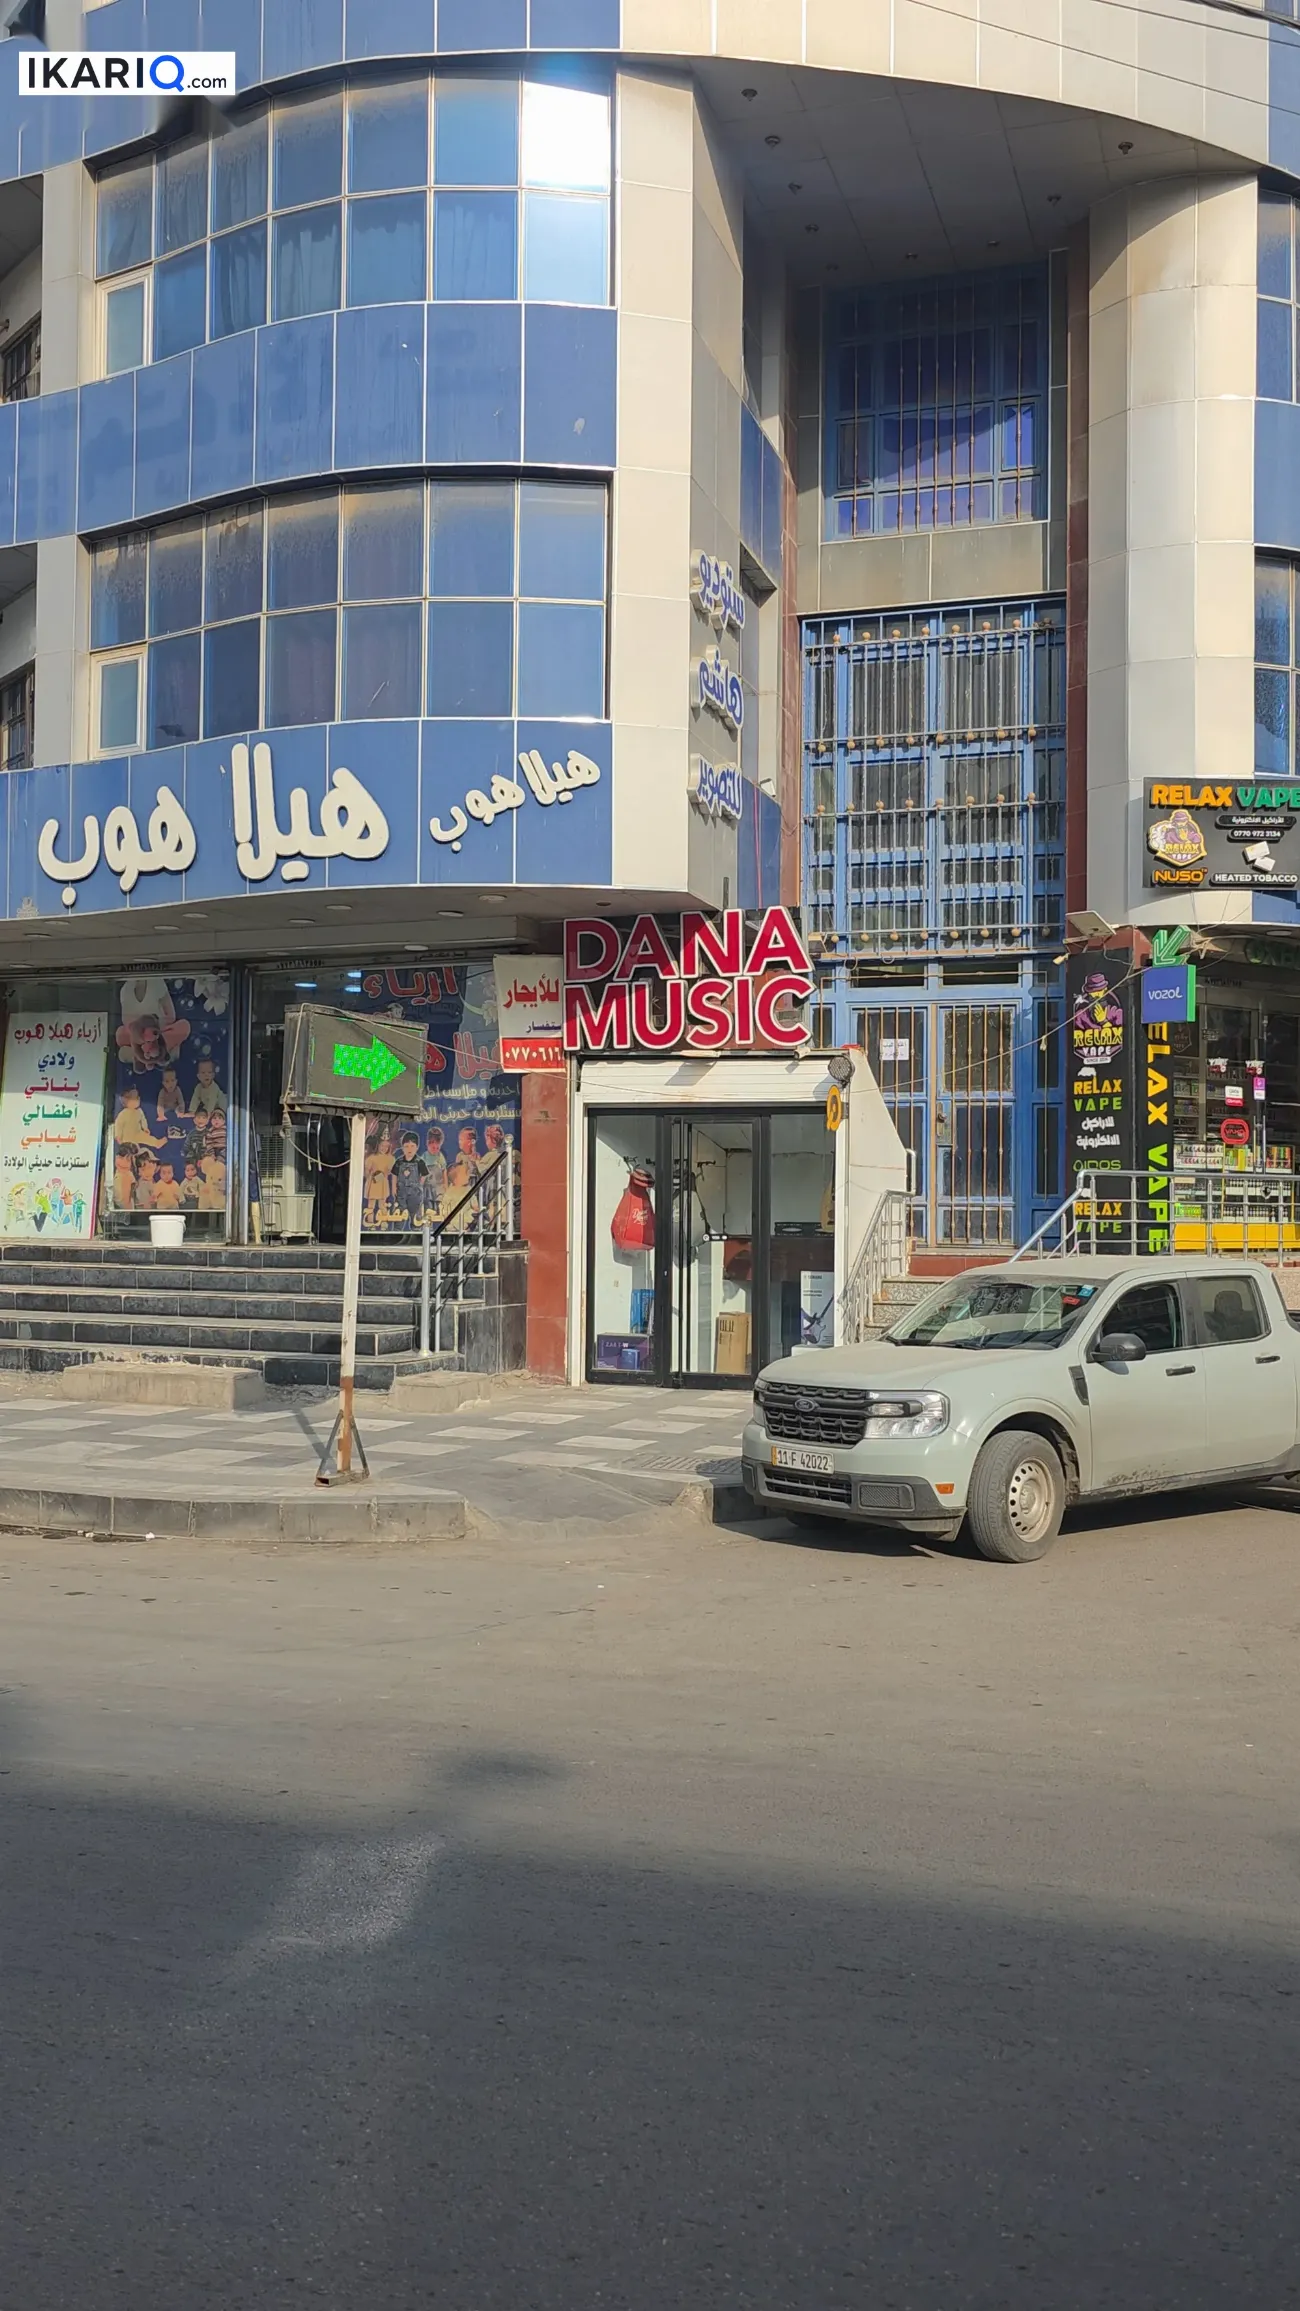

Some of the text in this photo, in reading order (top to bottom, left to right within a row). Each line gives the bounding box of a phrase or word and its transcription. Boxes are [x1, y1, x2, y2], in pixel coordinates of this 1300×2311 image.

[699, 551, 745, 629] ستوديو
[699, 649, 743, 727] هاشم
[429, 749, 601, 853] هيلا هوب
[1151, 784, 1300, 808] RELAX VAPE
[38, 743, 390, 906] هيلا هوب
[1215, 874, 1298, 883] HEATED TOBACCO
[564, 906, 814, 984] DANA
[564, 975, 816, 1050] MUSIC
[14, 1023, 45, 1044] هوب
[1074, 1022, 1123, 1047] RELAX
[38, 1052, 75, 1072] ولادي
[1082, 1046, 1112, 1056] VAPE
[24, 1077, 80, 1099] بناتي
[1073, 1078, 1122, 1095] RELAX
[1073, 1097, 1122, 1112] VAPE
[21, 1127, 76, 1149] شبابي
[1147, 1022, 1170, 1253] ELAX VAPE
[778, 1450, 829, 1470] 11 F 42022
